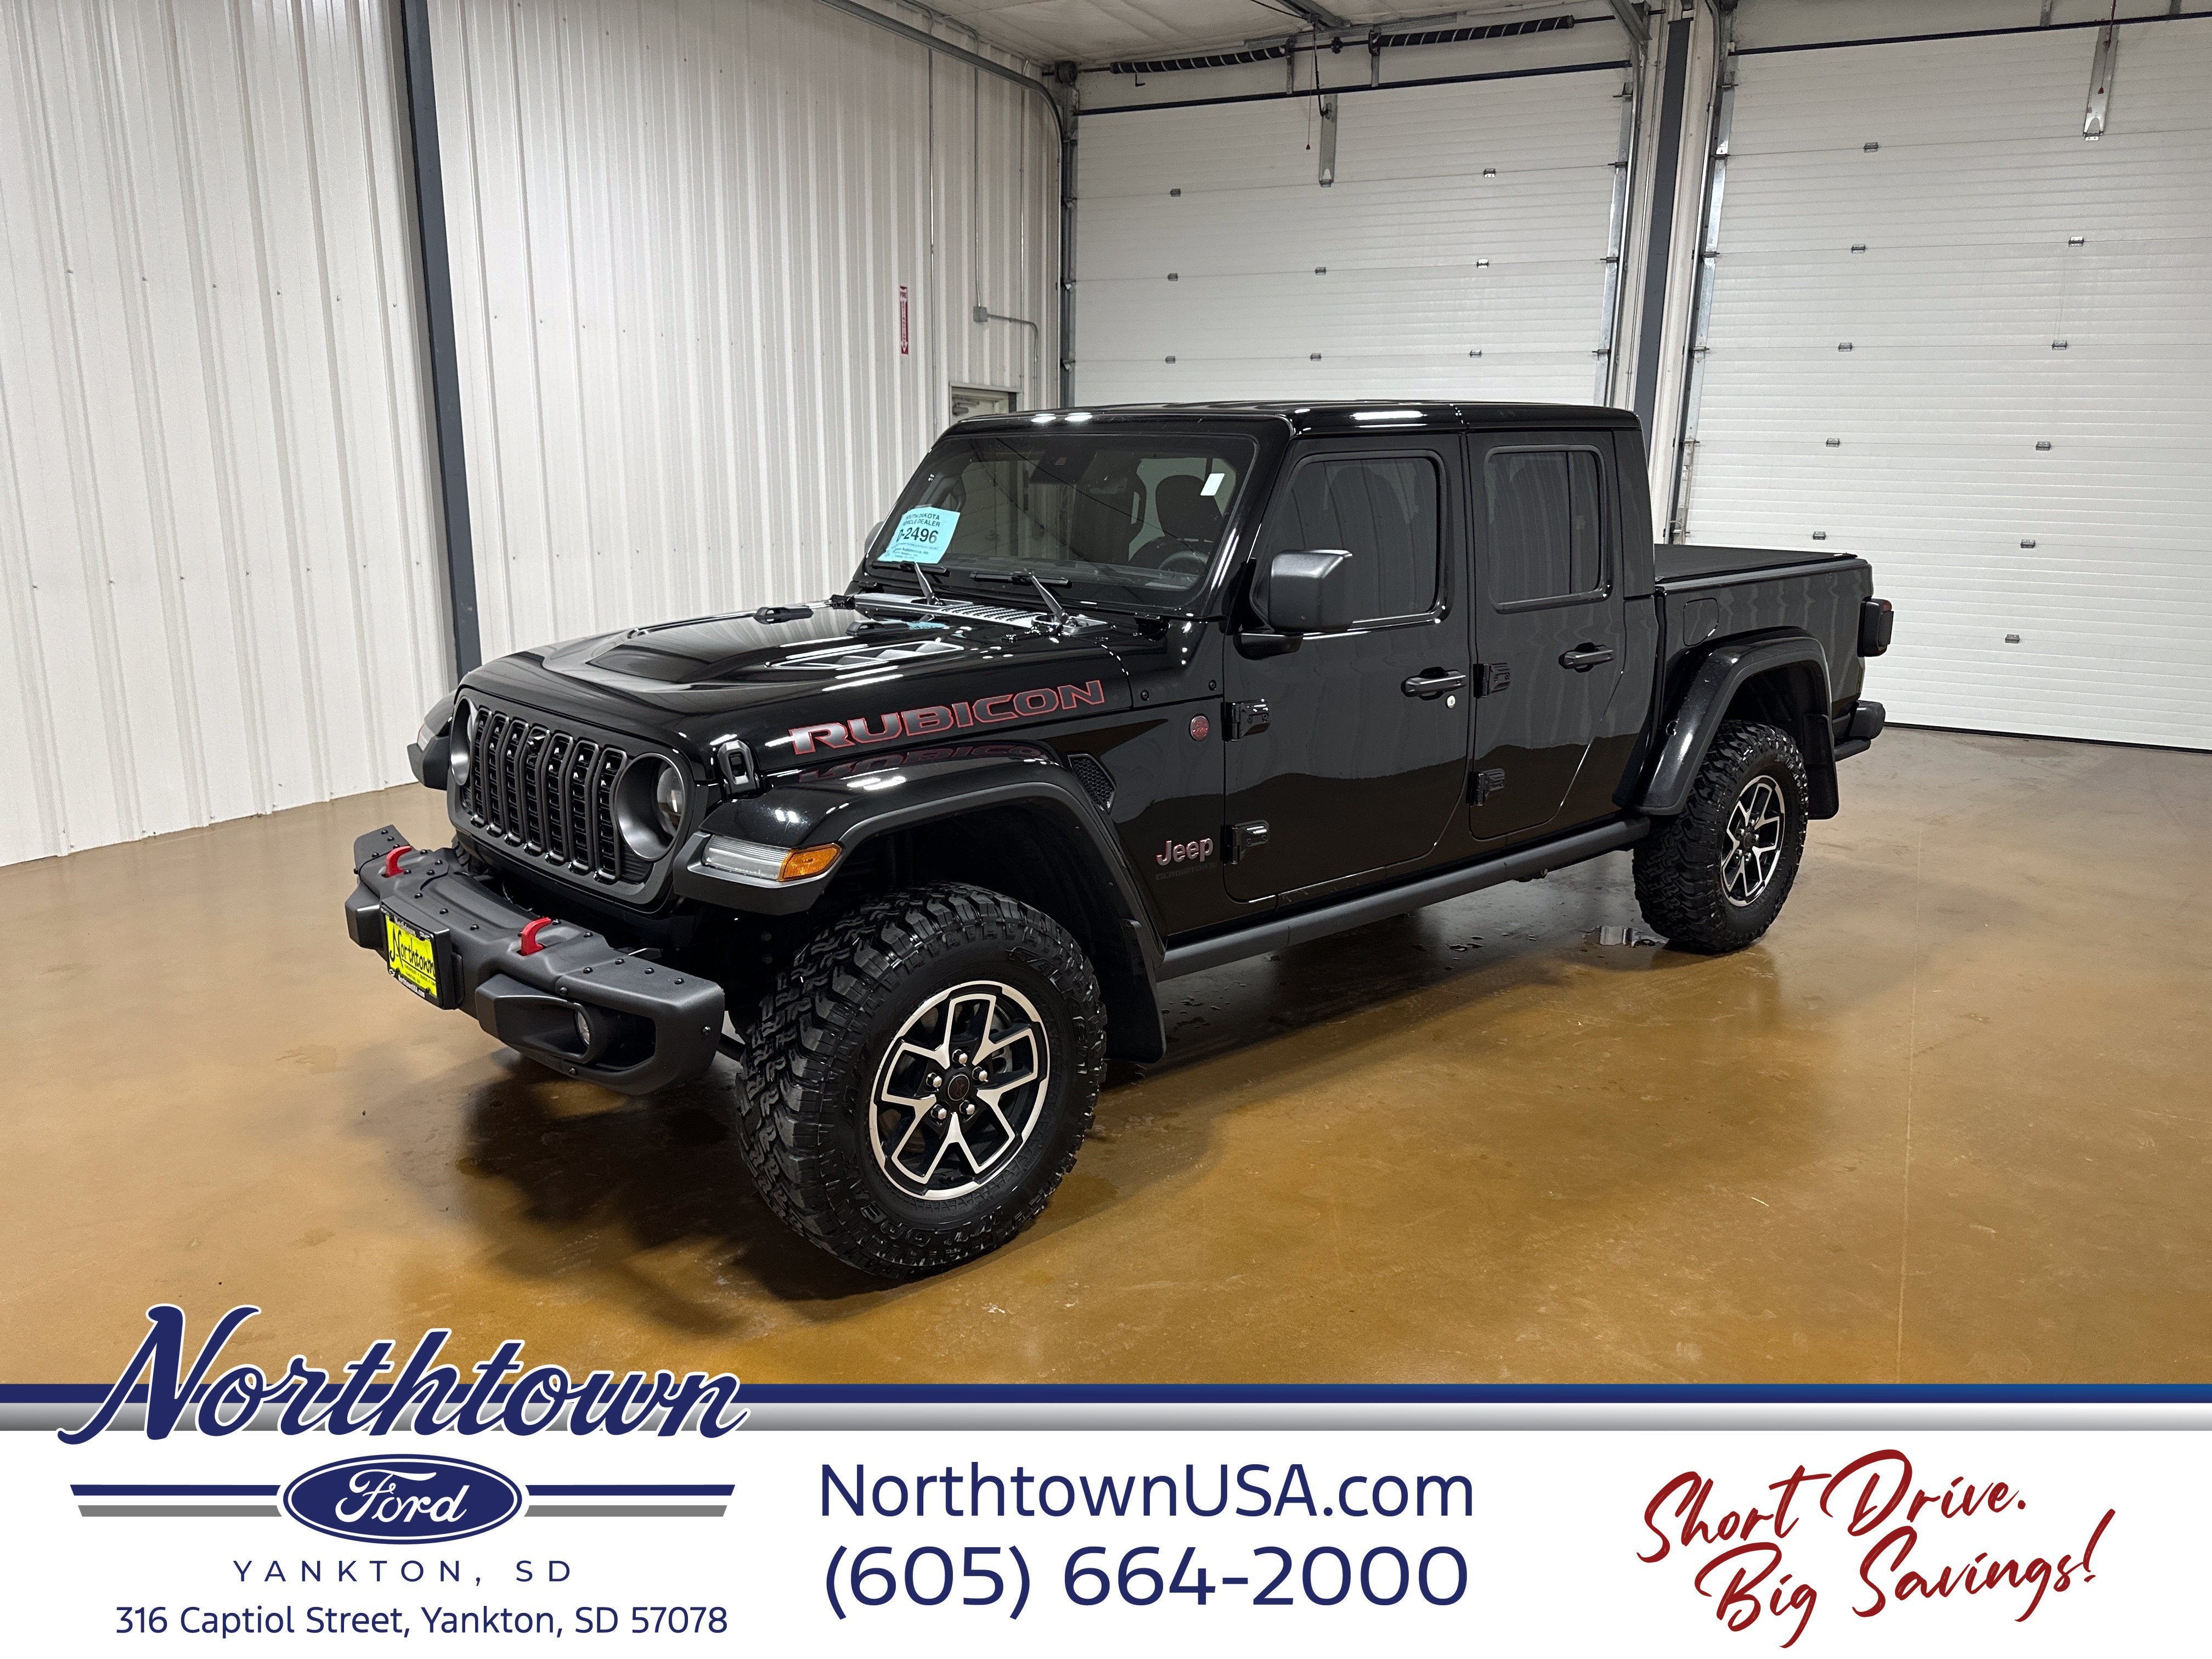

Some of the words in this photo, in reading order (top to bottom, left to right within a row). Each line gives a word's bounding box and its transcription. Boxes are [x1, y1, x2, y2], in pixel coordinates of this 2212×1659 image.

[917, 518, 940, 527] DEALER
[788, 680, 1105, 755] RUBICON
[1155, 838, 1214, 866] Jeep
[389, 925, 436, 977] Northtown
